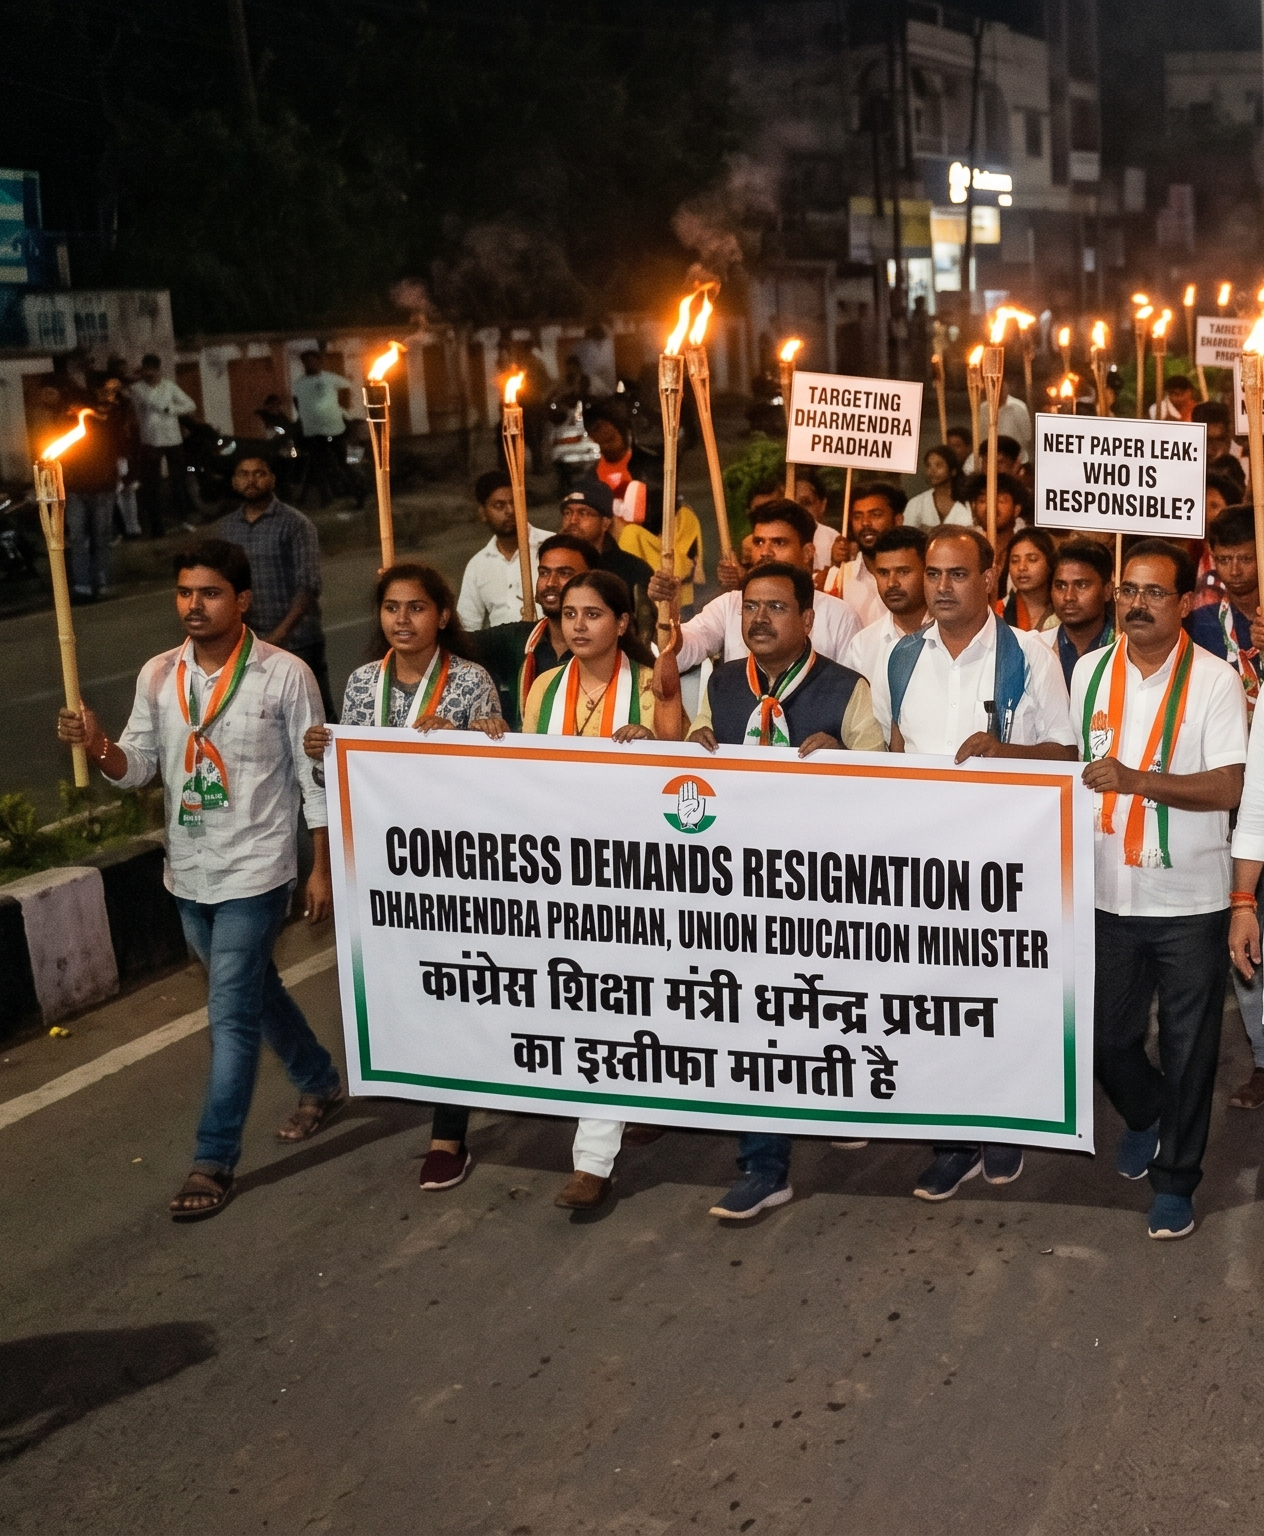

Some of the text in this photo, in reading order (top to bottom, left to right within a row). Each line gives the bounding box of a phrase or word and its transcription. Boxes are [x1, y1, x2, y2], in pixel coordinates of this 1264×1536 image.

[809, 386, 901, 412] TARGETING
[794, 408, 912, 437] DHARMENDRA
[811, 434, 892, 459] PRADHAN
[1043, 432, 1198, 462] NEET PAPER LEAK:
[1083, 462, 1157, 489] WHO IS
[1045, 489, 1195, 521] RESPONSIBLE?
[385, 826, 1024, 913] CONGRESS DEMANDS RESIGNATION OF
[369, 888, 1049, 969] DHARMENDRA PRADHAN, UNION EDUCATION MINISTER
[418, 950, 999, 1038] कांग्रेस शिक्षा मंत्री धर्मेन्द्र प्रधान
[510, 1029, 899, 1100] का इस्तीफा मांगती है
